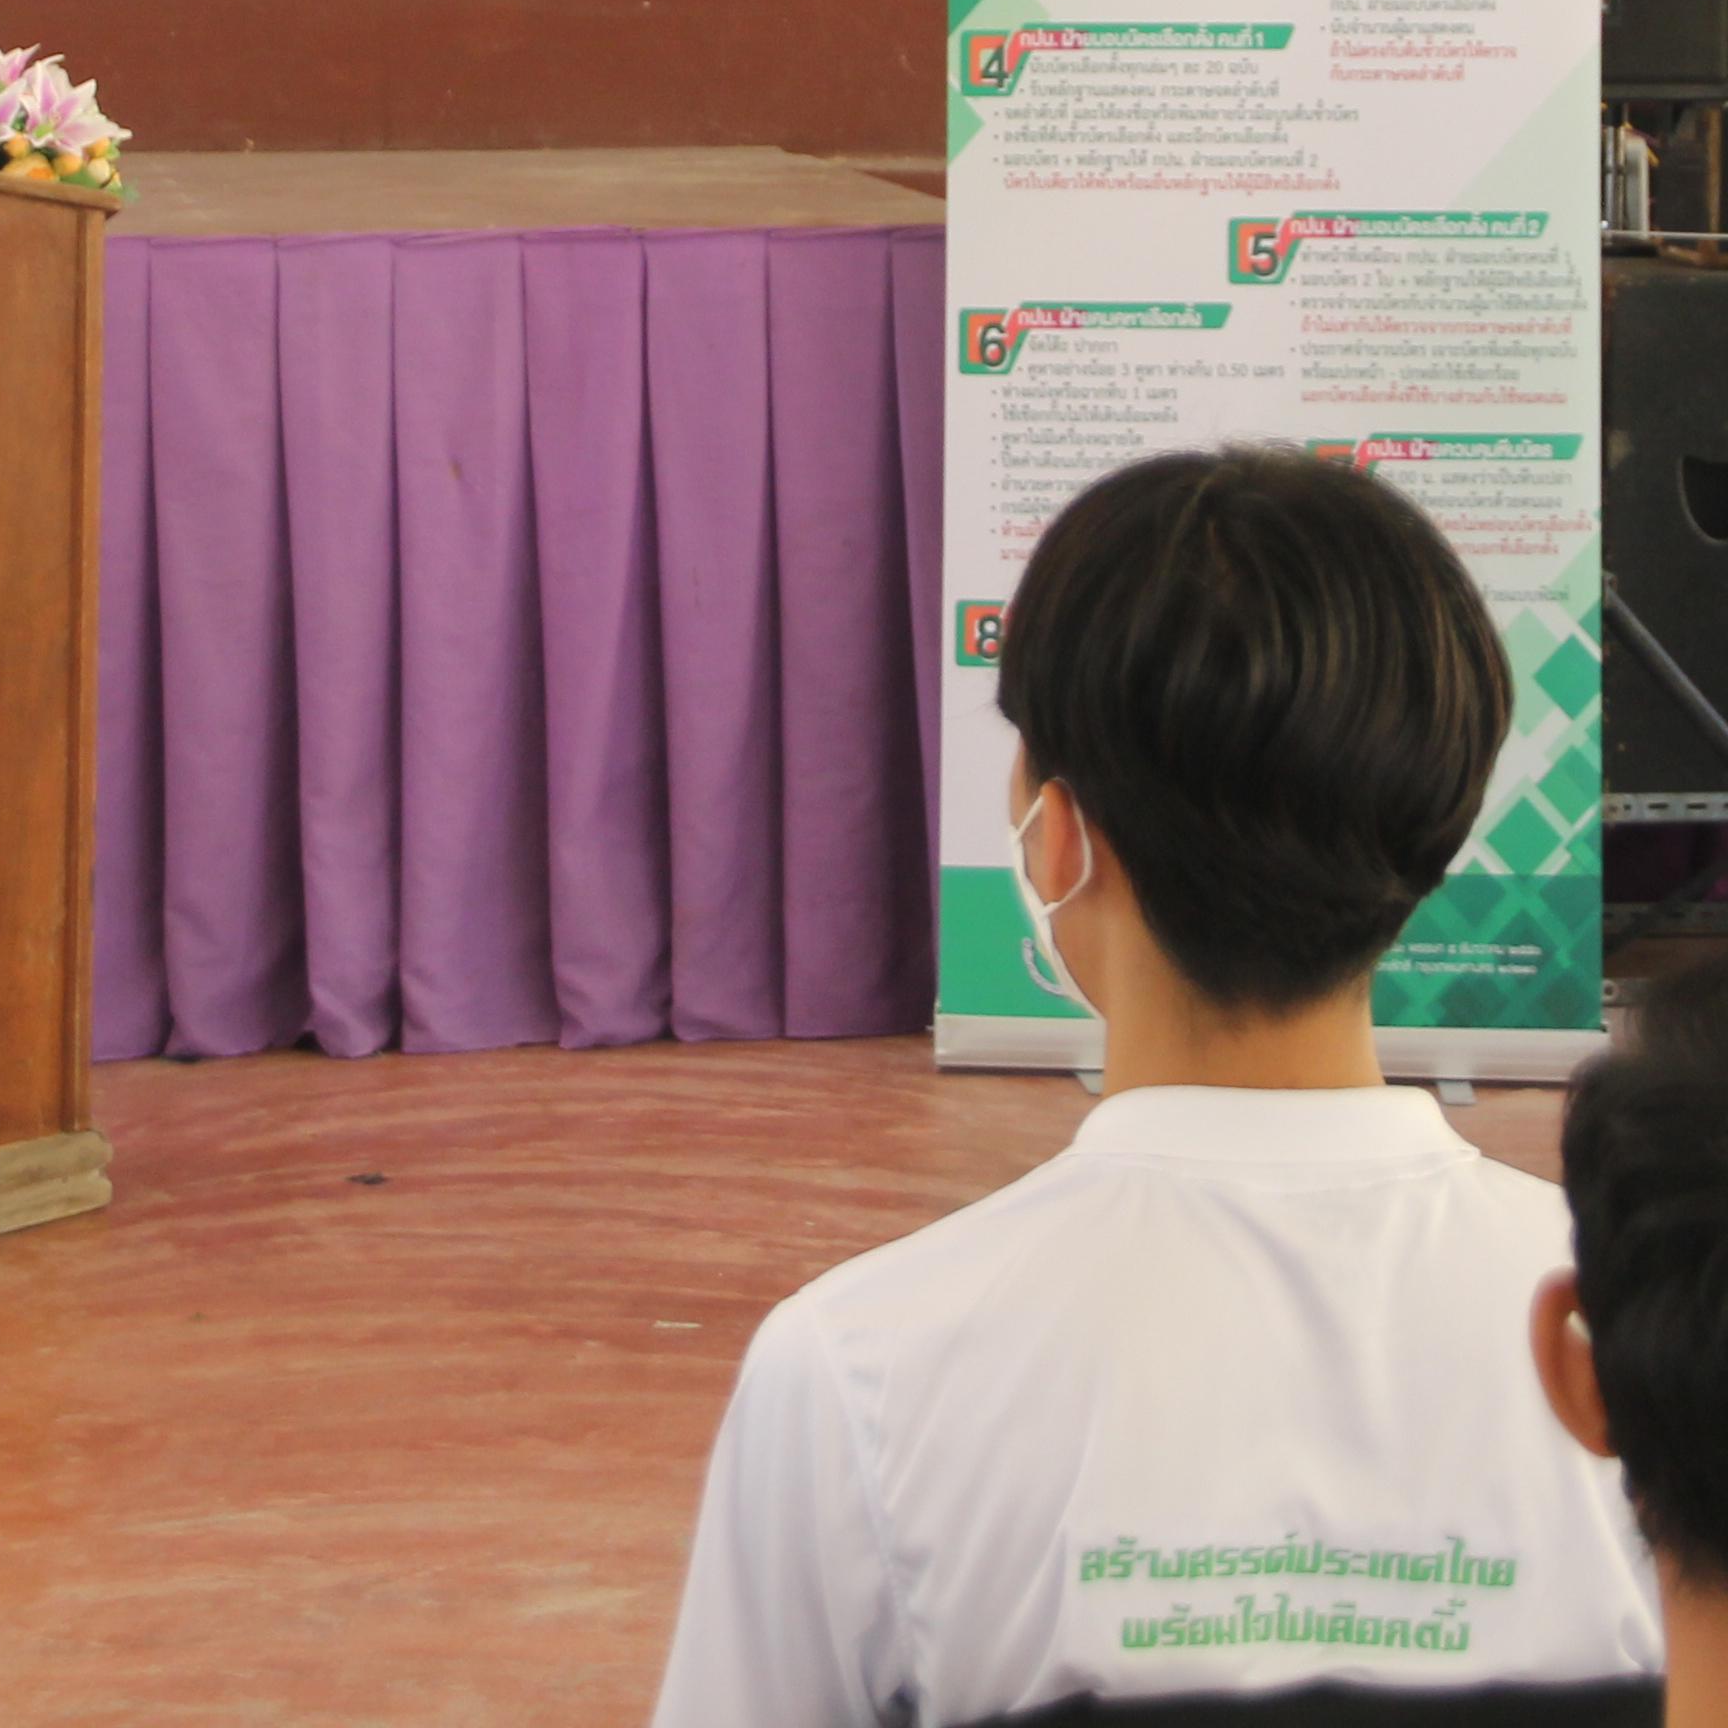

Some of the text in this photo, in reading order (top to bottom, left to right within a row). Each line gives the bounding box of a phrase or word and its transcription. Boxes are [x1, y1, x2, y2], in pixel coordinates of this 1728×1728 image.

[979, 43, 1010, 90] 4
[1250, 232, 1281, 278] 5
[979, 323, 1009, 368] 6
